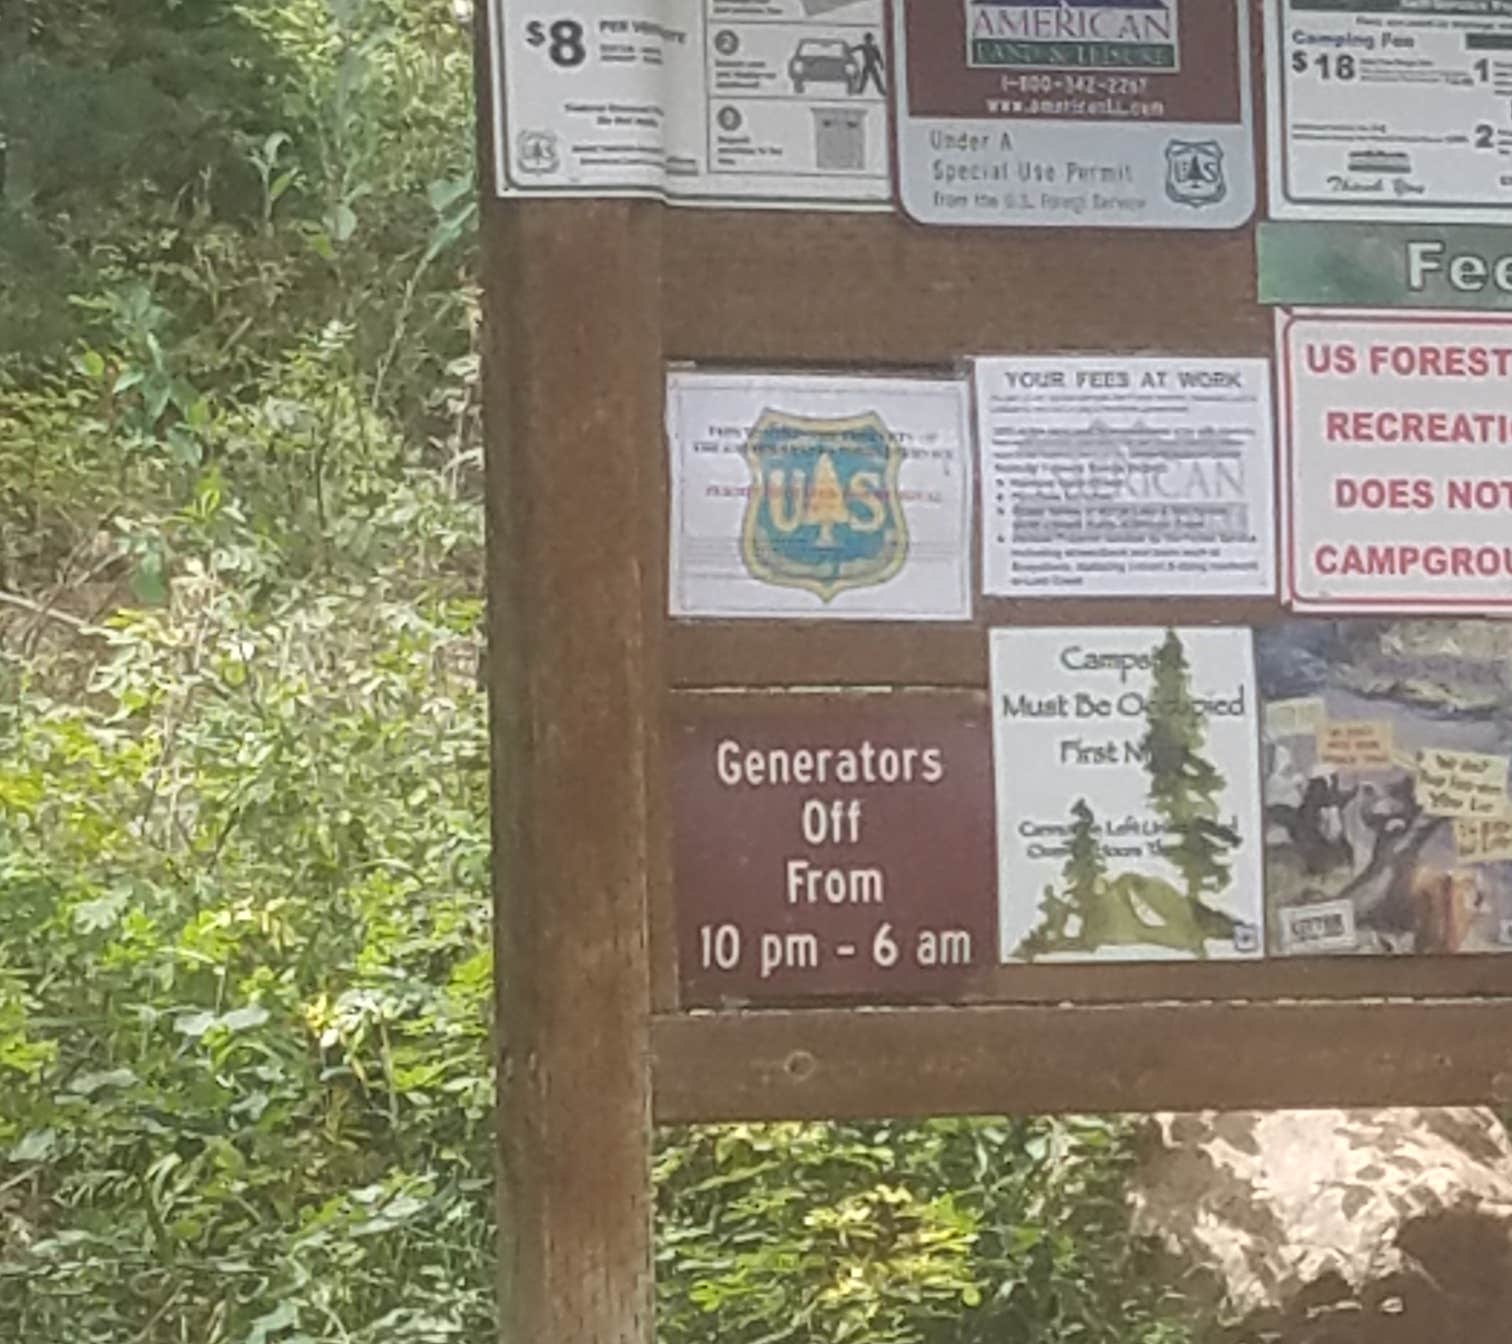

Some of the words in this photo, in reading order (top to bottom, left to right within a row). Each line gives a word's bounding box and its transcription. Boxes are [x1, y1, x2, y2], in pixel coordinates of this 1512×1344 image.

[974, 9, 1171, 40] AMERICAN
[1292, 29, 1375, 50] Camping
[929, 129, 990, 153] Under
[1000, 132, 1013, 152] A
[1474, 124, 1495, 149] 2
[932, 158, 1009, 183] Special
[1016, 160, 1055, 182] Use
[1065, 161, 1133, 184] Permit
[1306, 343, 1358, 375] US
[1005, 371, 1066, 389] YOUR
[1075, 371, 1130, 389] FEES
[1139, 371, 1168, 388] AT
[1177, 371, 1243, 388] WORK
[1334, 478, 1435, 511] DOES
[1002, 694, 1068, 718] Must
[1074, 692, 1112, 718] Be
[716, 739, 943, 785] Generators
[1060, 739, 1118, 765] First
[802, 799, 862, 844] Off
[786, 860, 884, 904] From
[700, 923, 740, 970] 10
[760, 932, 819, 979] pm
[872, 922, 899, 967] 6
[916, 929, 972, 966] am
